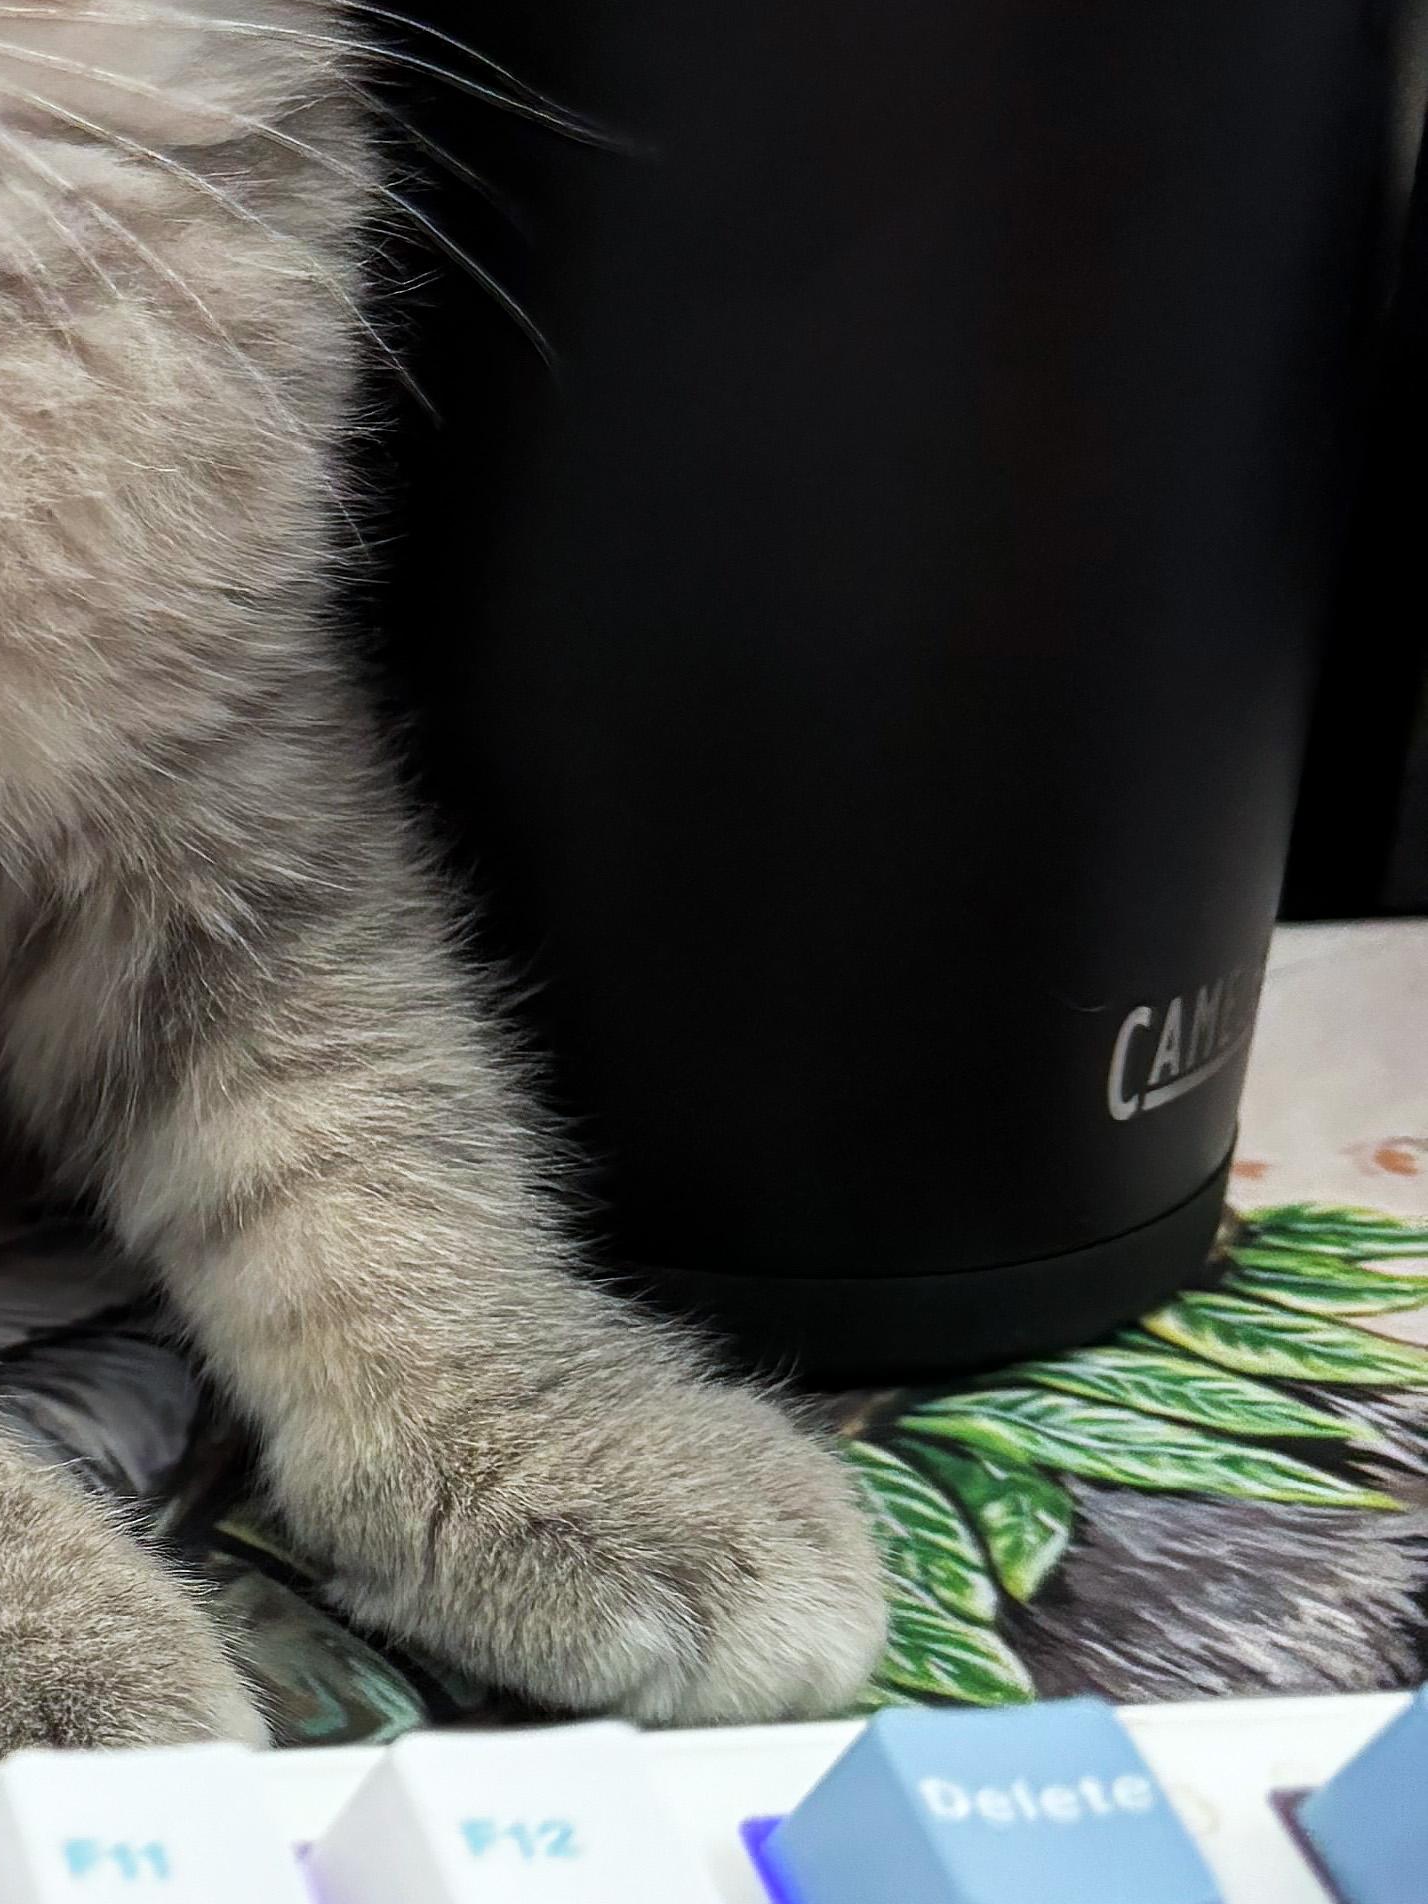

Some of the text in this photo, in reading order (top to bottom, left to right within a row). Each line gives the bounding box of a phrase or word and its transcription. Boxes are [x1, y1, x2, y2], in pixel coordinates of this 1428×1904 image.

[918, 1775, 1153, 1822] Delete
[63, 1838, 170, 1881] F11
[461, 1818, 579, 1860] F12
